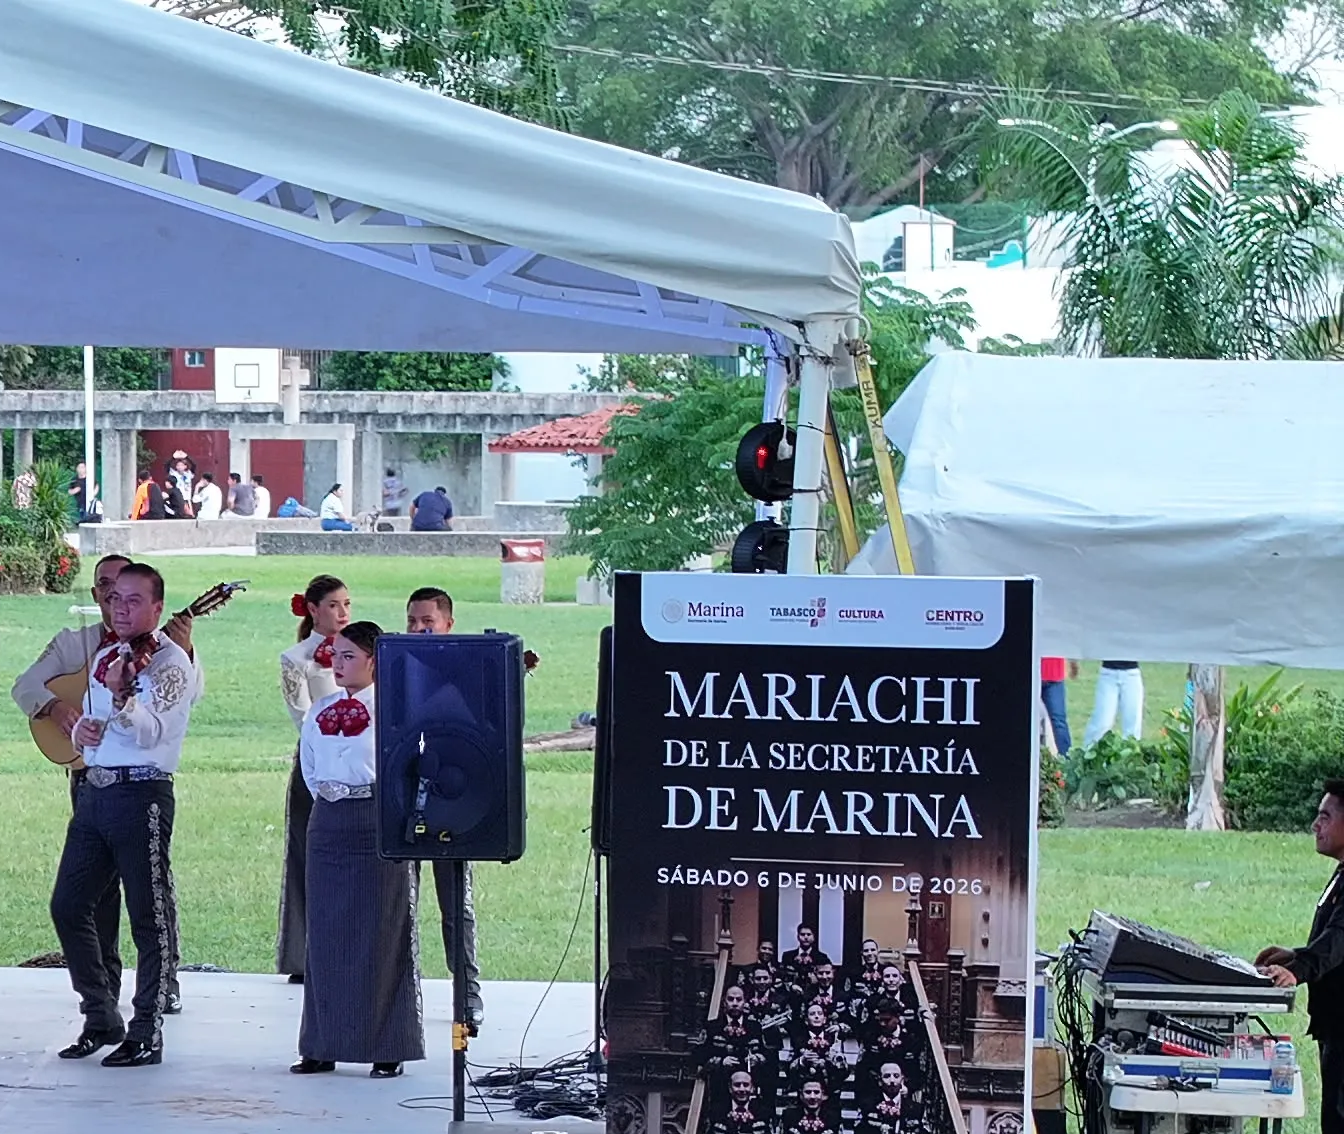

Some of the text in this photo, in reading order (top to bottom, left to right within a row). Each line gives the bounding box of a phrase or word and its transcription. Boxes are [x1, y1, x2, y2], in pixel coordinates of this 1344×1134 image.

[687, 601, 744, 617] Marina
[769, 607, 816, 617] TABASCO
[838, 609, 885, 619] CULTURA
[925, 609, 984, 622] CENTRO
[664, 670, 980, 725] MARIACHI
[662, 739, 980, 776] DE LA SECRETARÍA
[661, 785, 983, 839] DE MARINA
[657, 864, 983, 896] SÁBADO 6 DE JUNIO DE 2026
